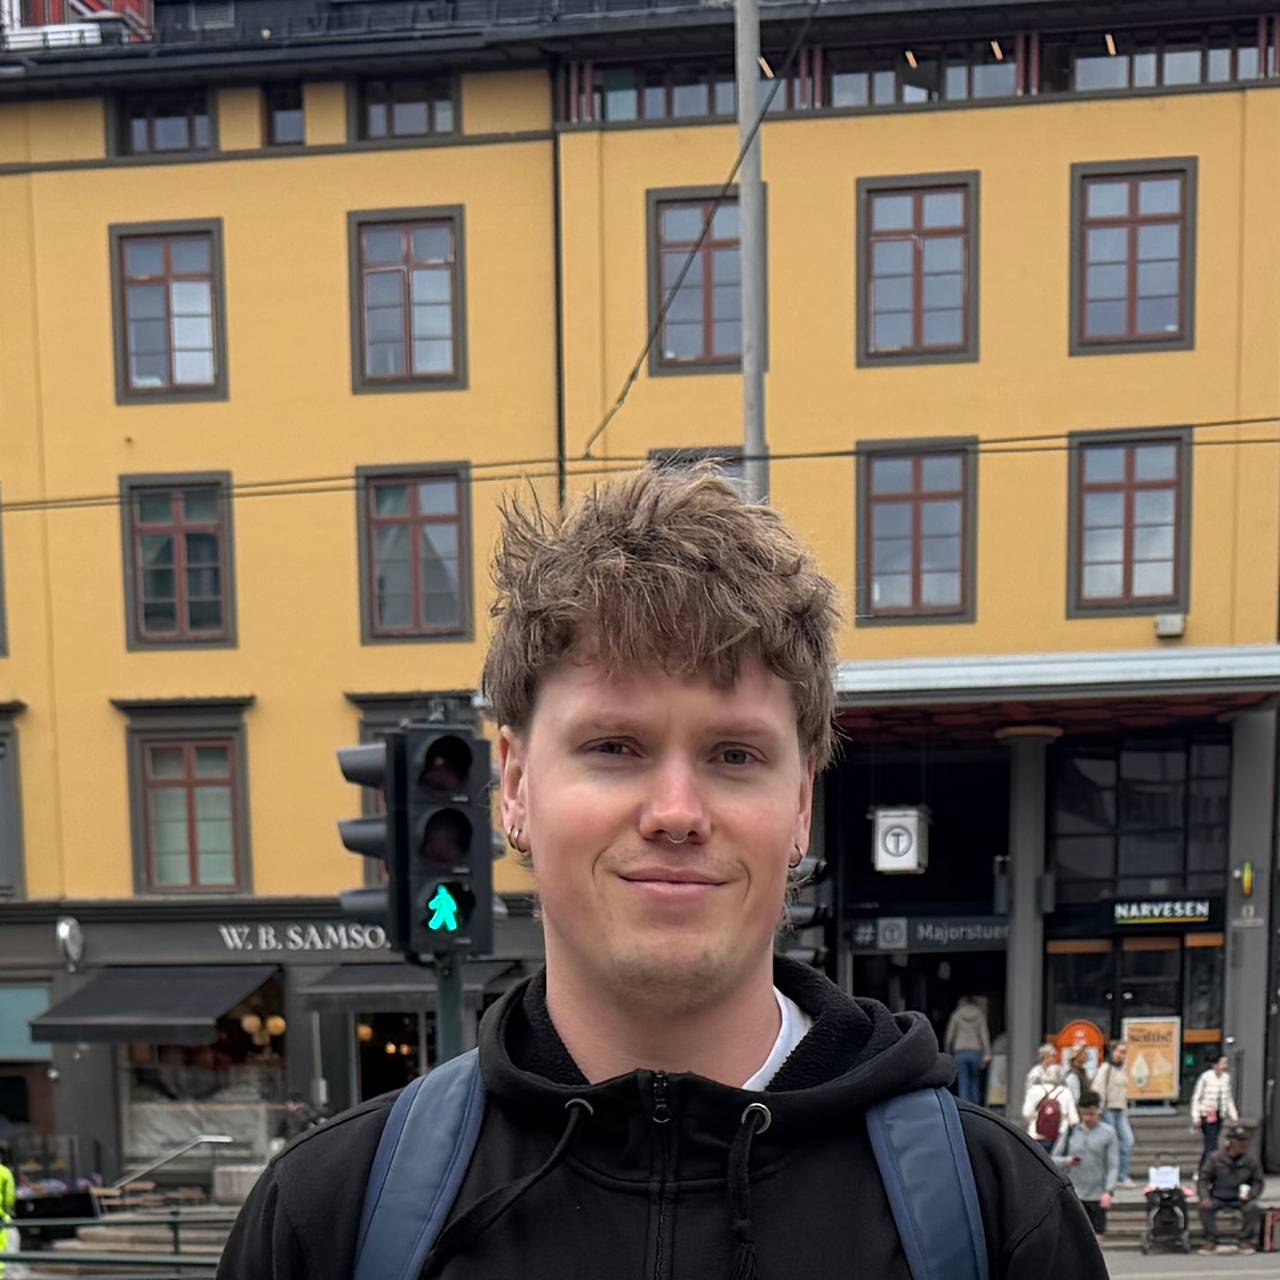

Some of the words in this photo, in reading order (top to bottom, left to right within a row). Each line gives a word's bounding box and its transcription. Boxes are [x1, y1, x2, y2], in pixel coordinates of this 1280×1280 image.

[1114, 901, 1210, 918] NARVESEN
[219, 925, 253, 950] W.
[258, 924, 283, 949] B.
[286, 924, 392, 950] SAMSO
